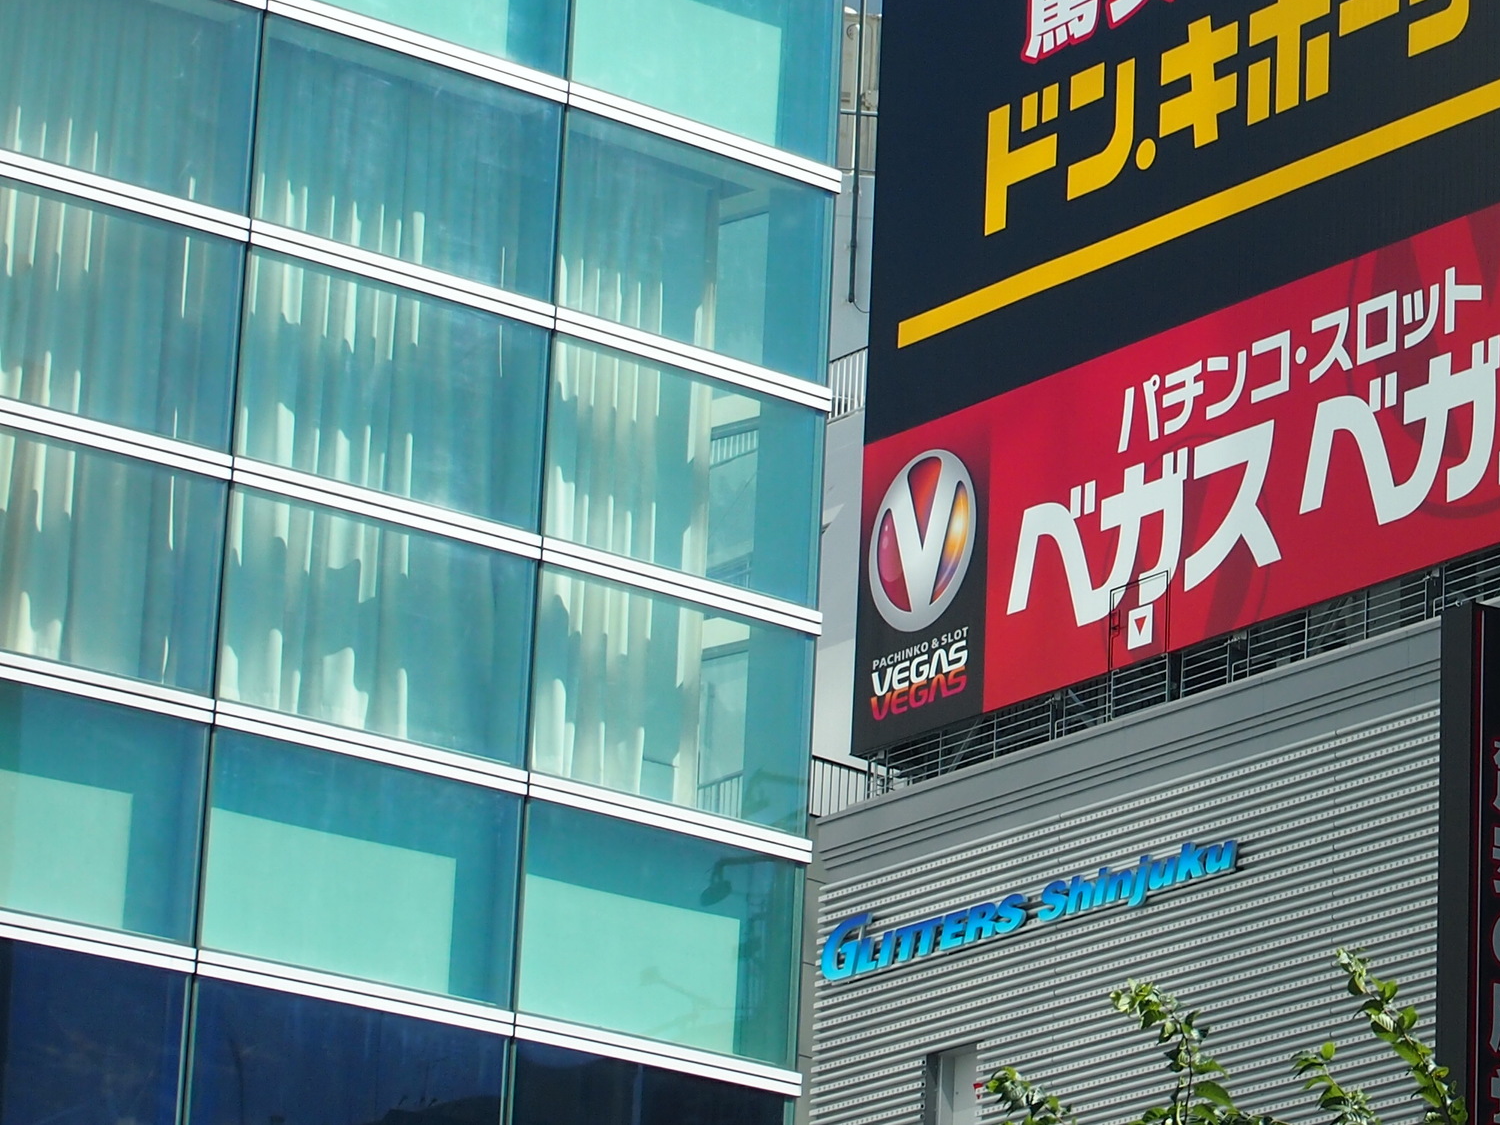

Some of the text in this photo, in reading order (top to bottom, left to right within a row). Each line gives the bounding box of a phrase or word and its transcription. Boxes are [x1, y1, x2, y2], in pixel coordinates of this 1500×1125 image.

[1005, 418, 1282, 629] ベガス
[871, 641, 968, 697] VEGAS
[872, 626, 969, 671] PACHINKO & SLOT
[820, 839, 1239, 981] GLITTERS Shinjuku
